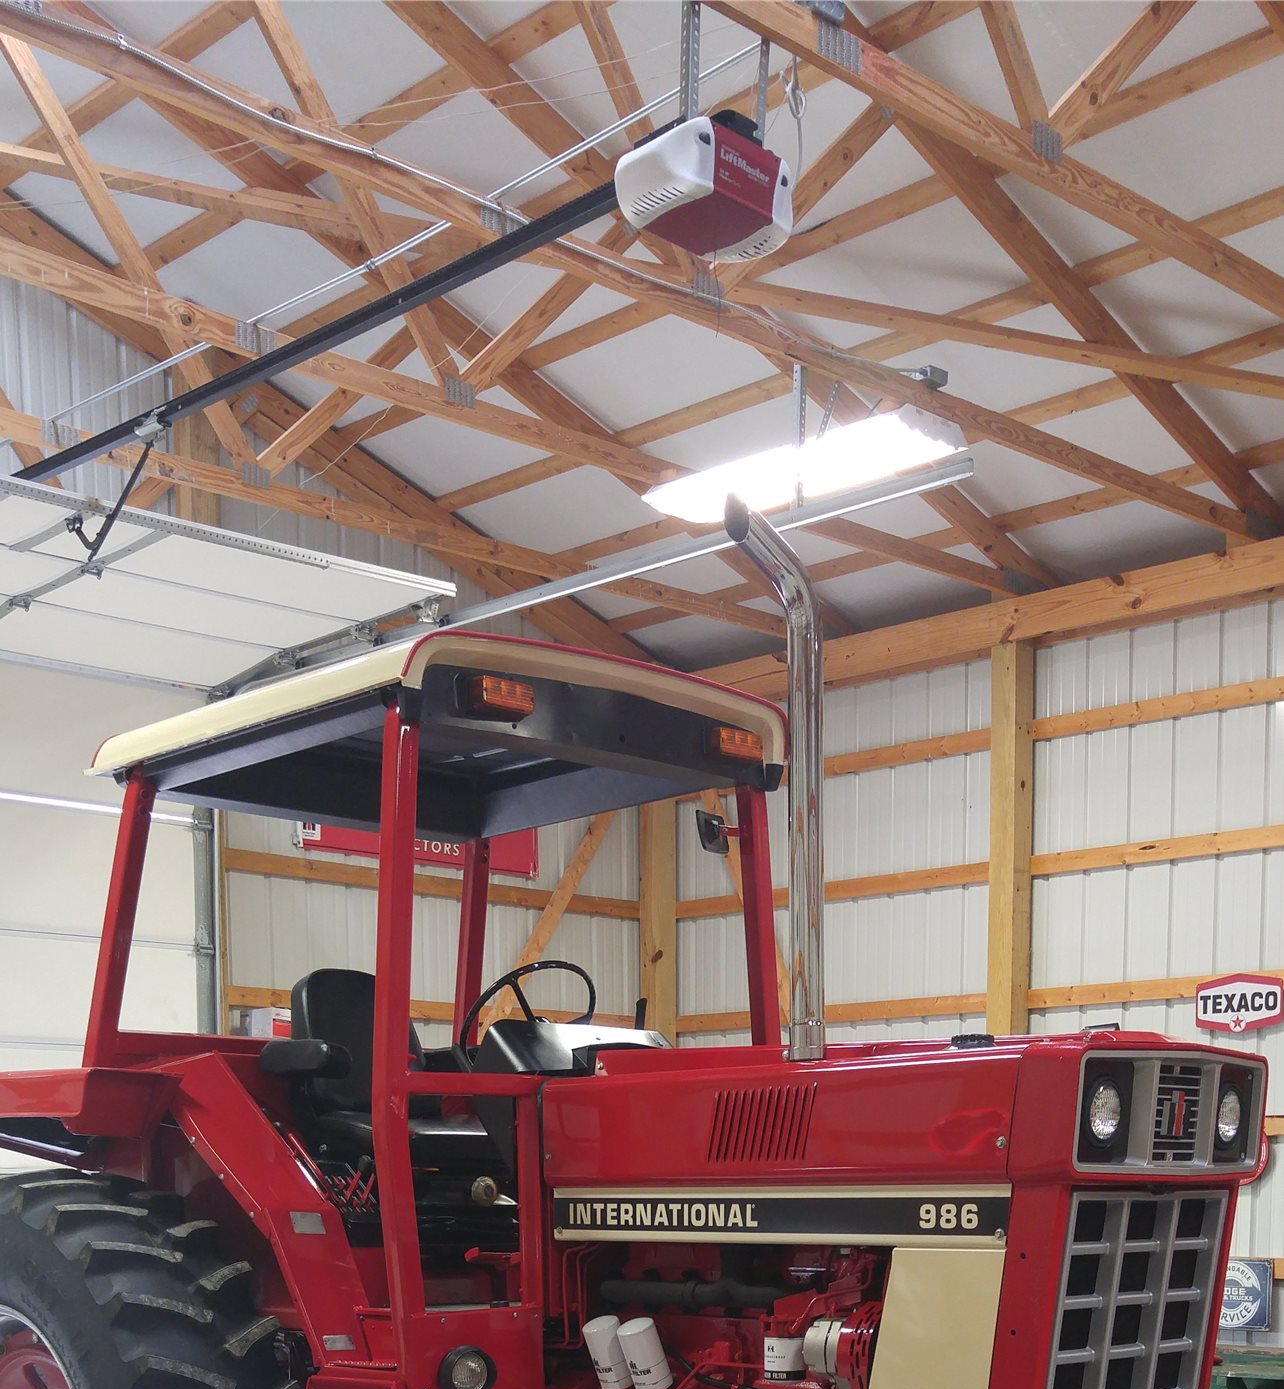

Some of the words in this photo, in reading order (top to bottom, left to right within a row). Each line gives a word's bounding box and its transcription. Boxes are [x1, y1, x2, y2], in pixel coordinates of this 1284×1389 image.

[720, 148, 770, 183] LiftMaster
[1199, 991, 1278, 1015] TEXACO
[569, 1203, 758, 1227] INTERNATIONAL
[919, 1203, 979, 1229] 986
